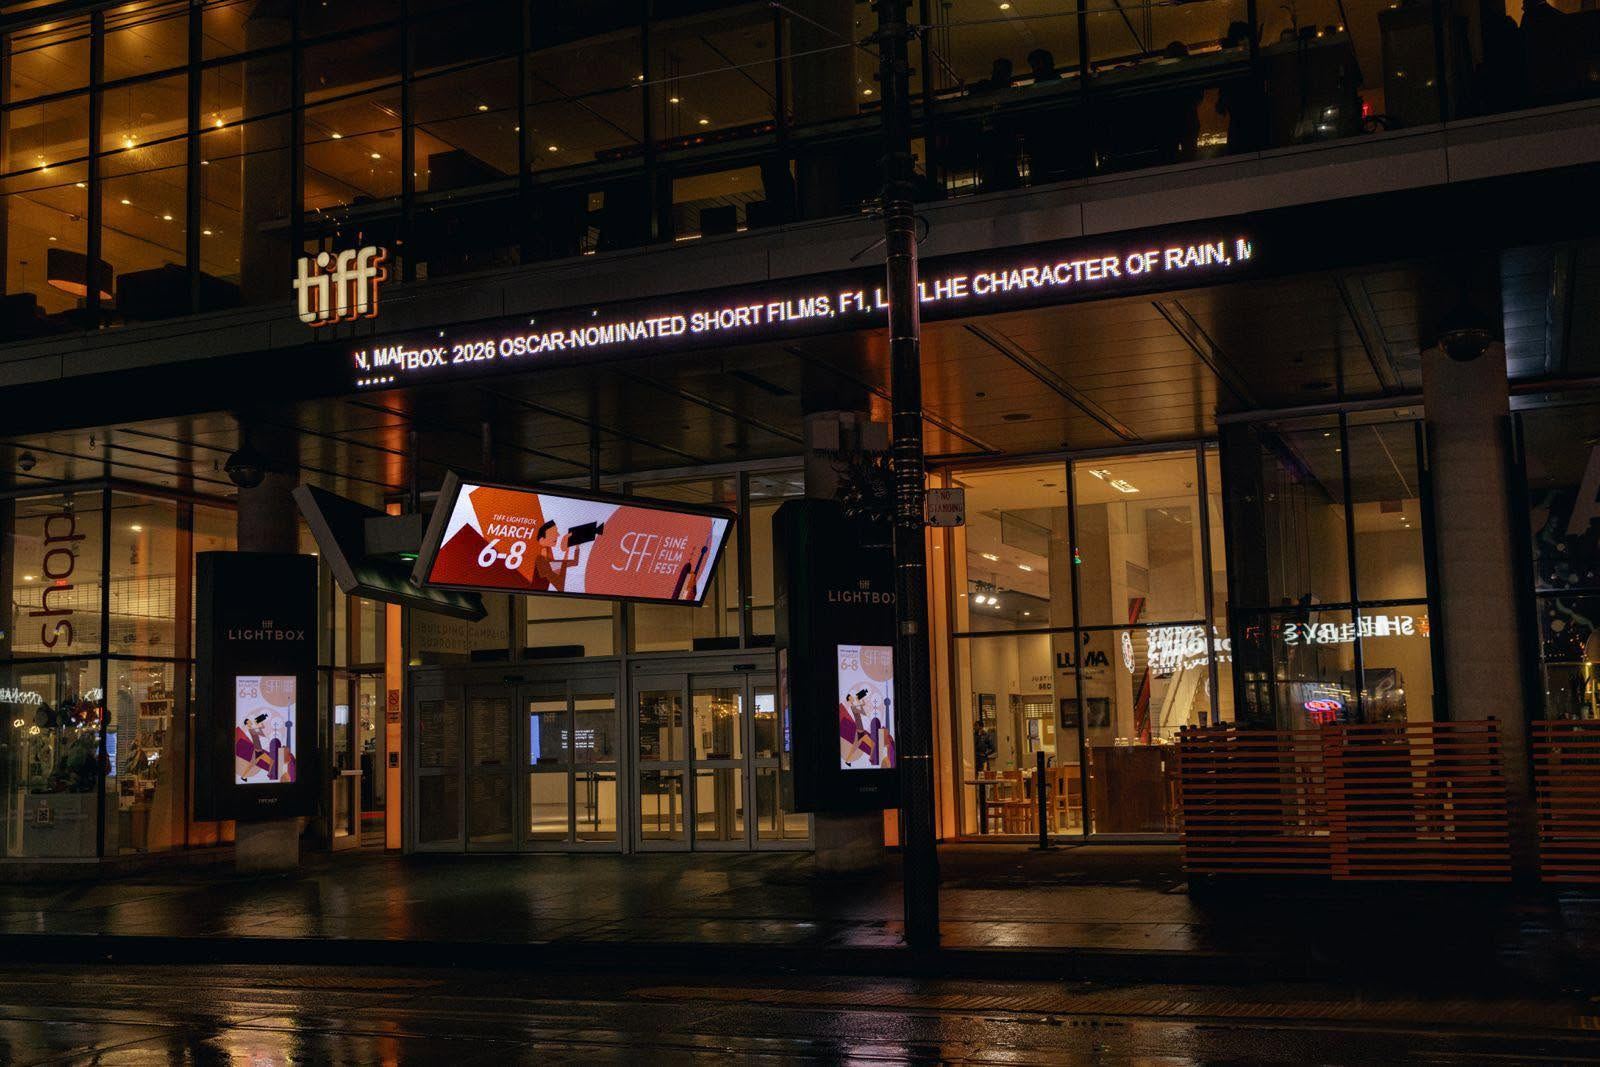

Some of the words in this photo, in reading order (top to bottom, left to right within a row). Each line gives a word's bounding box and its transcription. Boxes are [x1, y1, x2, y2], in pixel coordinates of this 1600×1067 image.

[293, 246, 380, 323] tiff
[453, 340, 495, 363] 2026
[500, 315, 686, 357] OSCAR-NOMINATED
[690, 304, 763, 333] SHORT
[767, 296, 835, 323] FILMS,
[839, 290, 871, 313] F1,
[973, 256, 1121, 295] CHARACTER
[1125, 250, 1160, 275] OF
[1164, 241, 1231, 271] RAIN,
[487, 523, 535, 539] MARCH
[477, 538, 527, 570] 6-8
[658, 549, 684, 562] FILM
[29, 512, 86, 648] shop
[653, 561, 679, 576] FEST
[228, 629, 305, 641] LIGHTBOX
